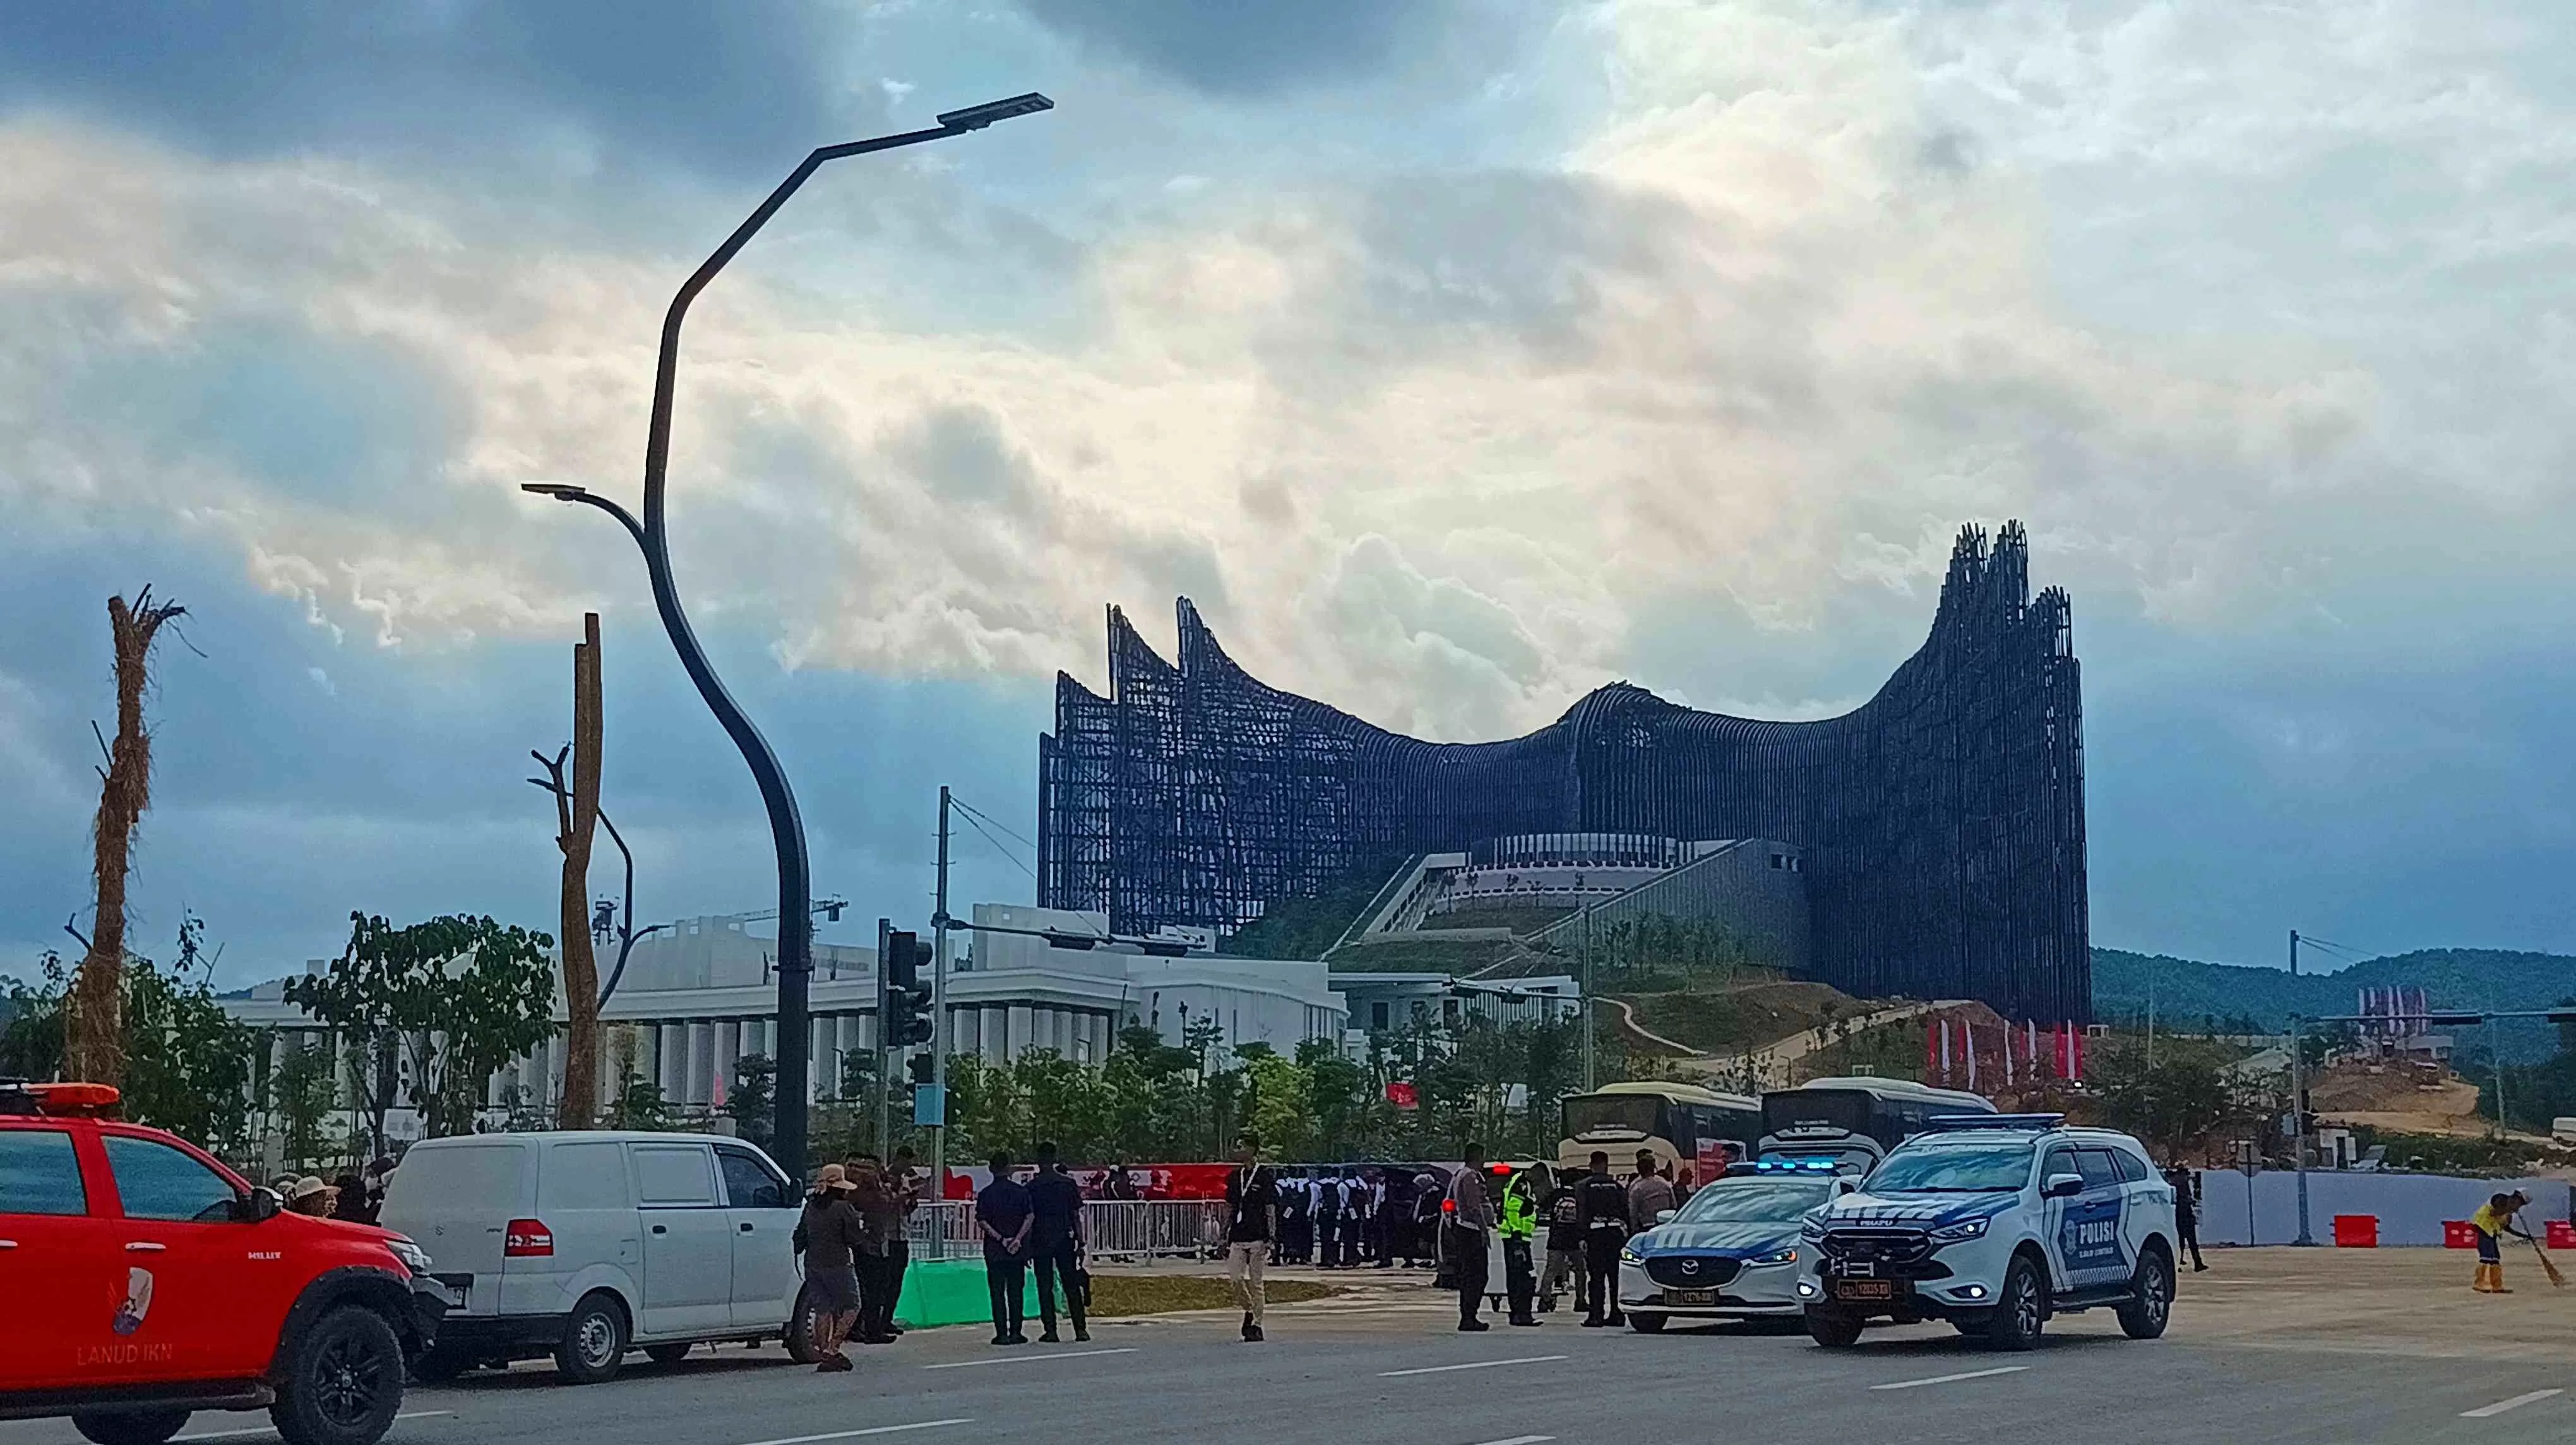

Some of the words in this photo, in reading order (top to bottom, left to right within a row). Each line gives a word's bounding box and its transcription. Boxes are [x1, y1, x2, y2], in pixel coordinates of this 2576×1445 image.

[2080, 1221, 2114, 1244] POLISI
[78, 1344, 138, 1365] LANUD
[143, 1343, 172, 1362] IKN
